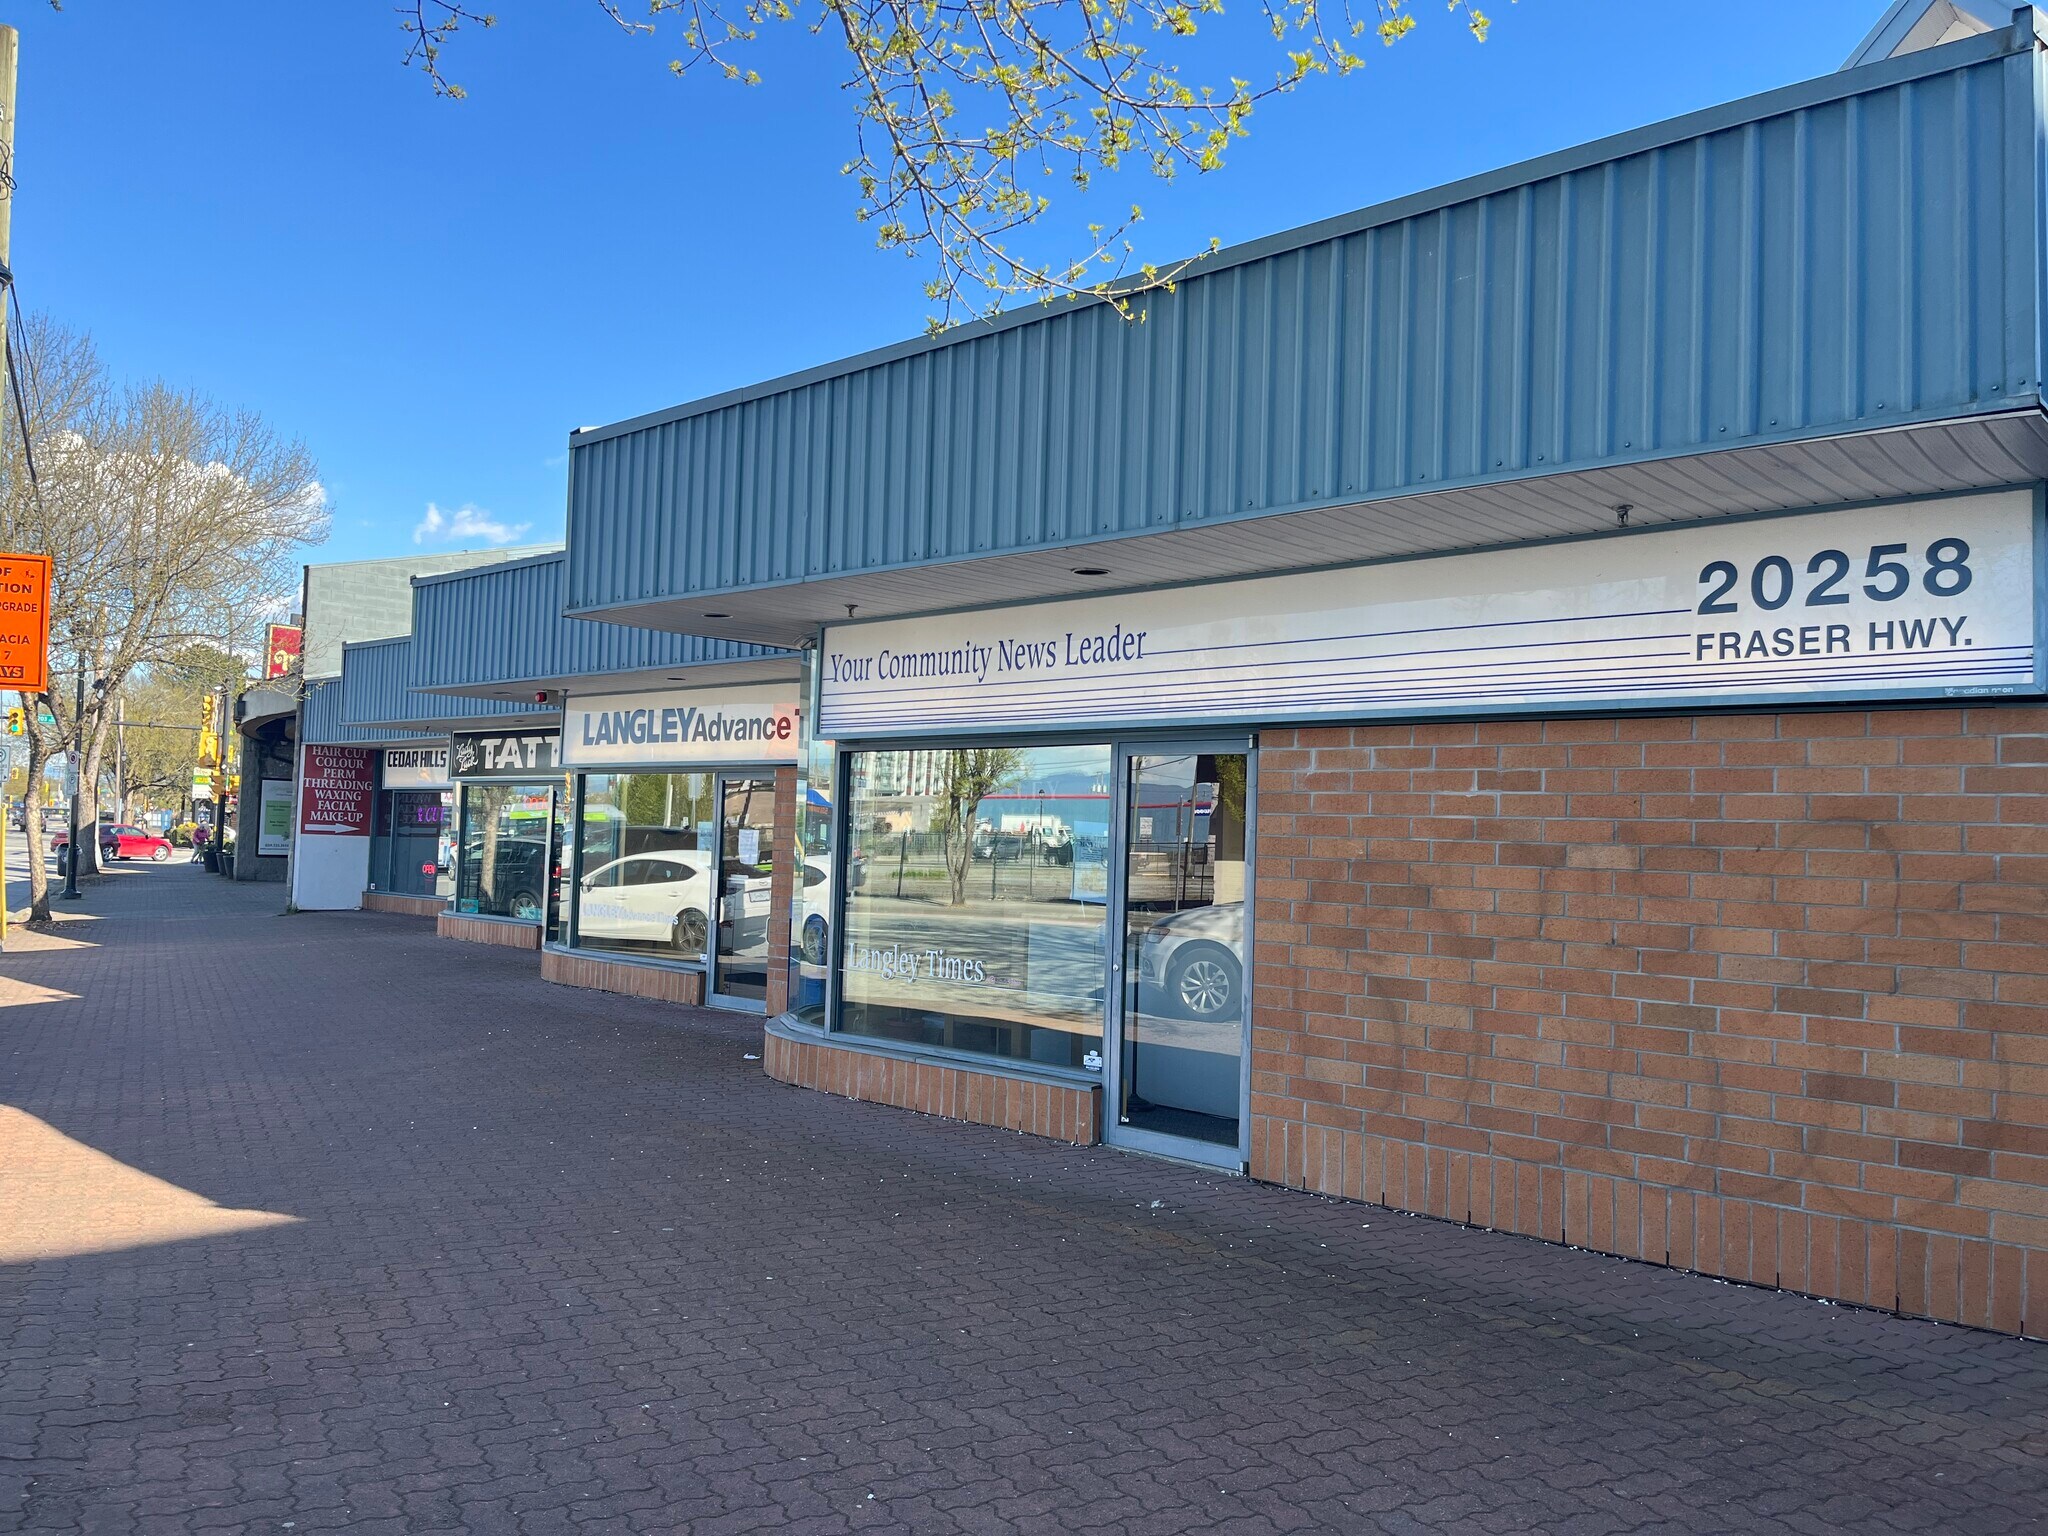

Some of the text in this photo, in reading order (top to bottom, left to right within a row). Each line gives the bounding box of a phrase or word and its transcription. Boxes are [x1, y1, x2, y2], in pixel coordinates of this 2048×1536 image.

[1697, 537, 1973, 615] 20258
[1696, 615, 1972, 661] FRASER HWY.
[830, 623, 1147, 683] Your Community News Leader
[312, 745, 369, 759] HAIR CUT
[456, 738, 475, 760] Lady
[315, 756, 365, 769] COLOUR
[387, 750, 447, 768] CEDAR HILLS
[458, 758, 479, 773] Luck
[323, 767, 356, 779] PERM
[304, 777, 373, 791] THREADING
[315, 789, 362, 801] WAXING
[317, 800, 357, 811] FACIAL
[310, 811, 363, 822] MAKE-UP
[848, 942, 984, 984] Langley Times
